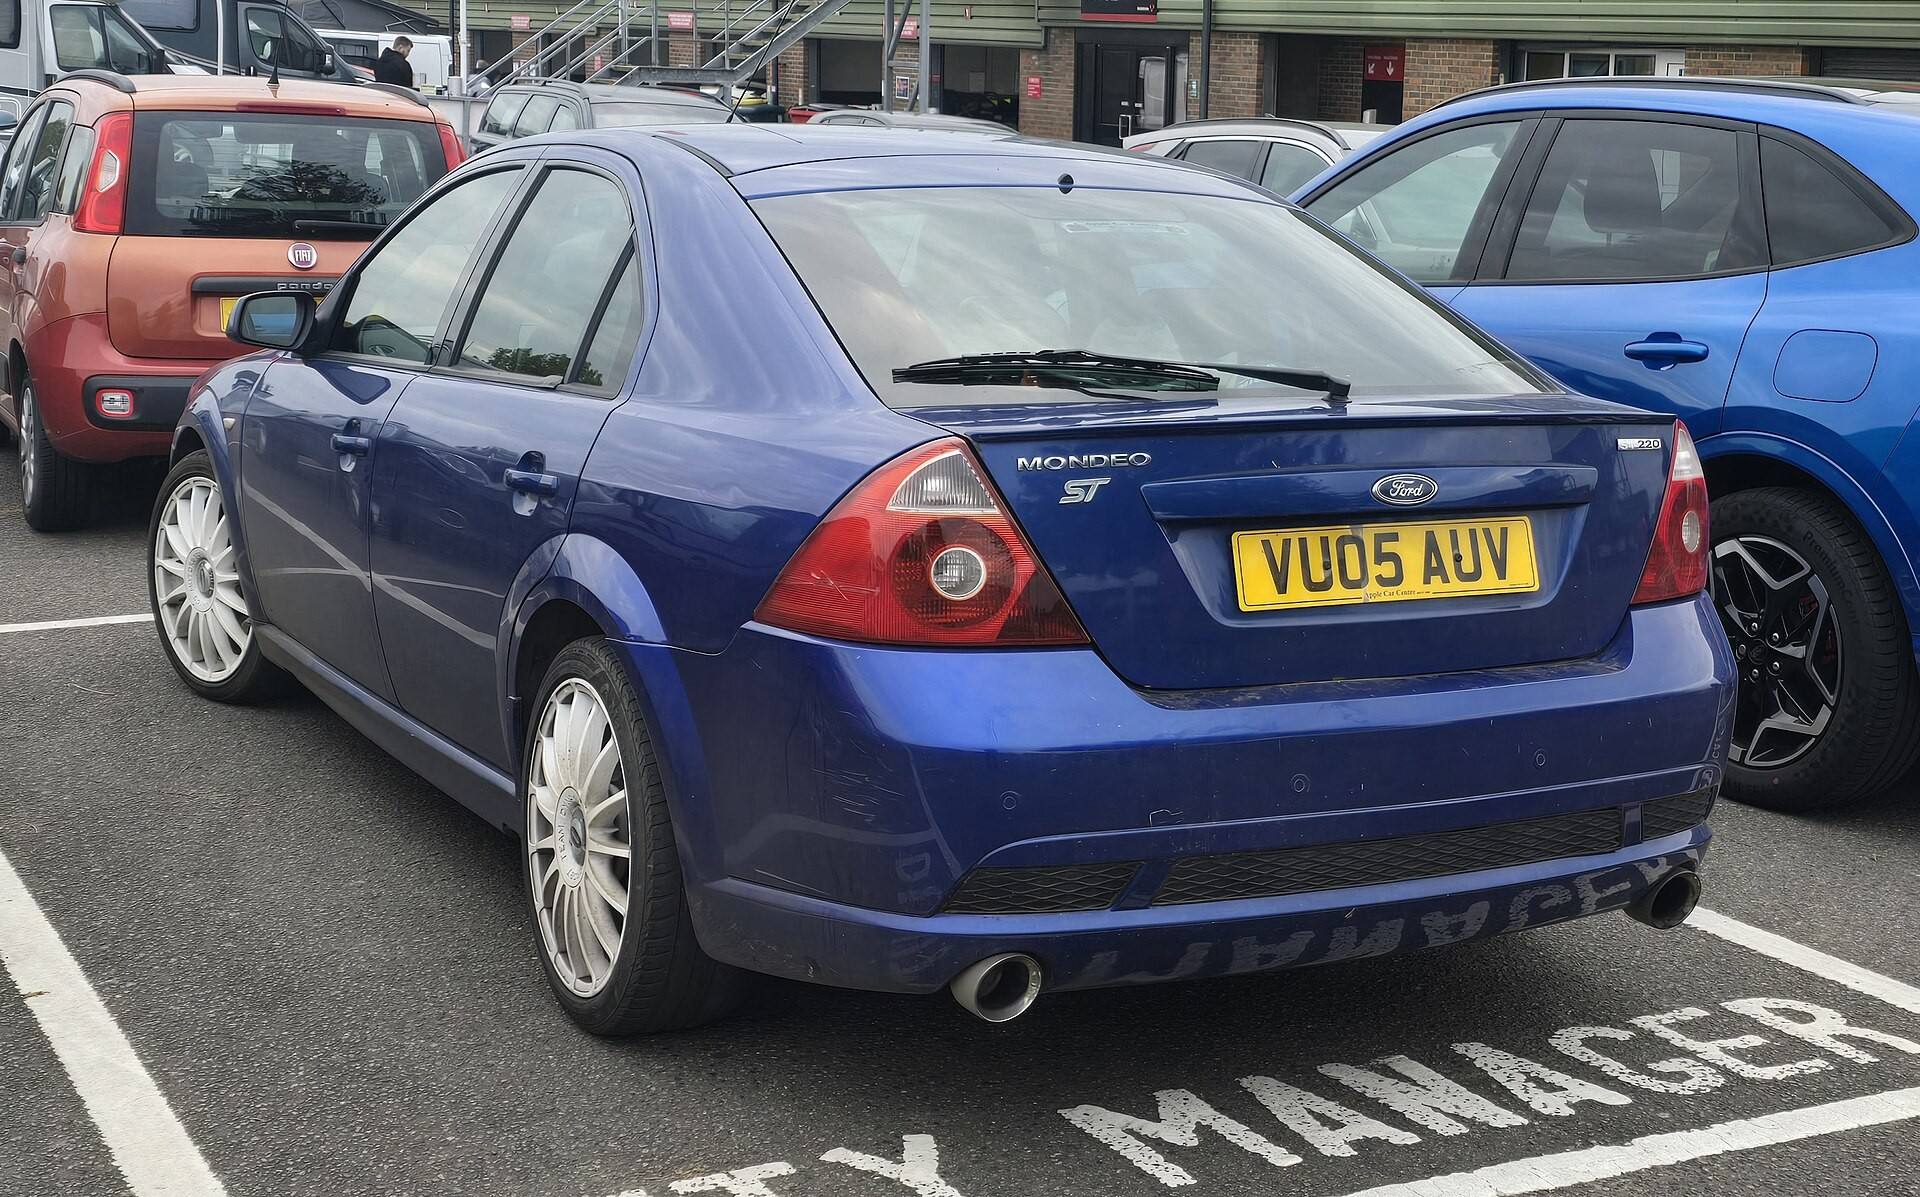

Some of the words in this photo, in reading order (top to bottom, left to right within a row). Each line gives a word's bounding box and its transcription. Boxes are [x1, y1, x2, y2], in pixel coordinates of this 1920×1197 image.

[294, 249, 311, 262] FIAT
[276, 281, 334, 291] panda
[1016, 452, 1152, 471] MONDEO
[1058, 477, 1112, 504] ST
[1389, 480, 1424, 497] Ford
[1261, 531, 1404, 595] VU05
[1422, 526, 1509, 586] AUV
[1057, 996, 1919, 1189] MANAGER
